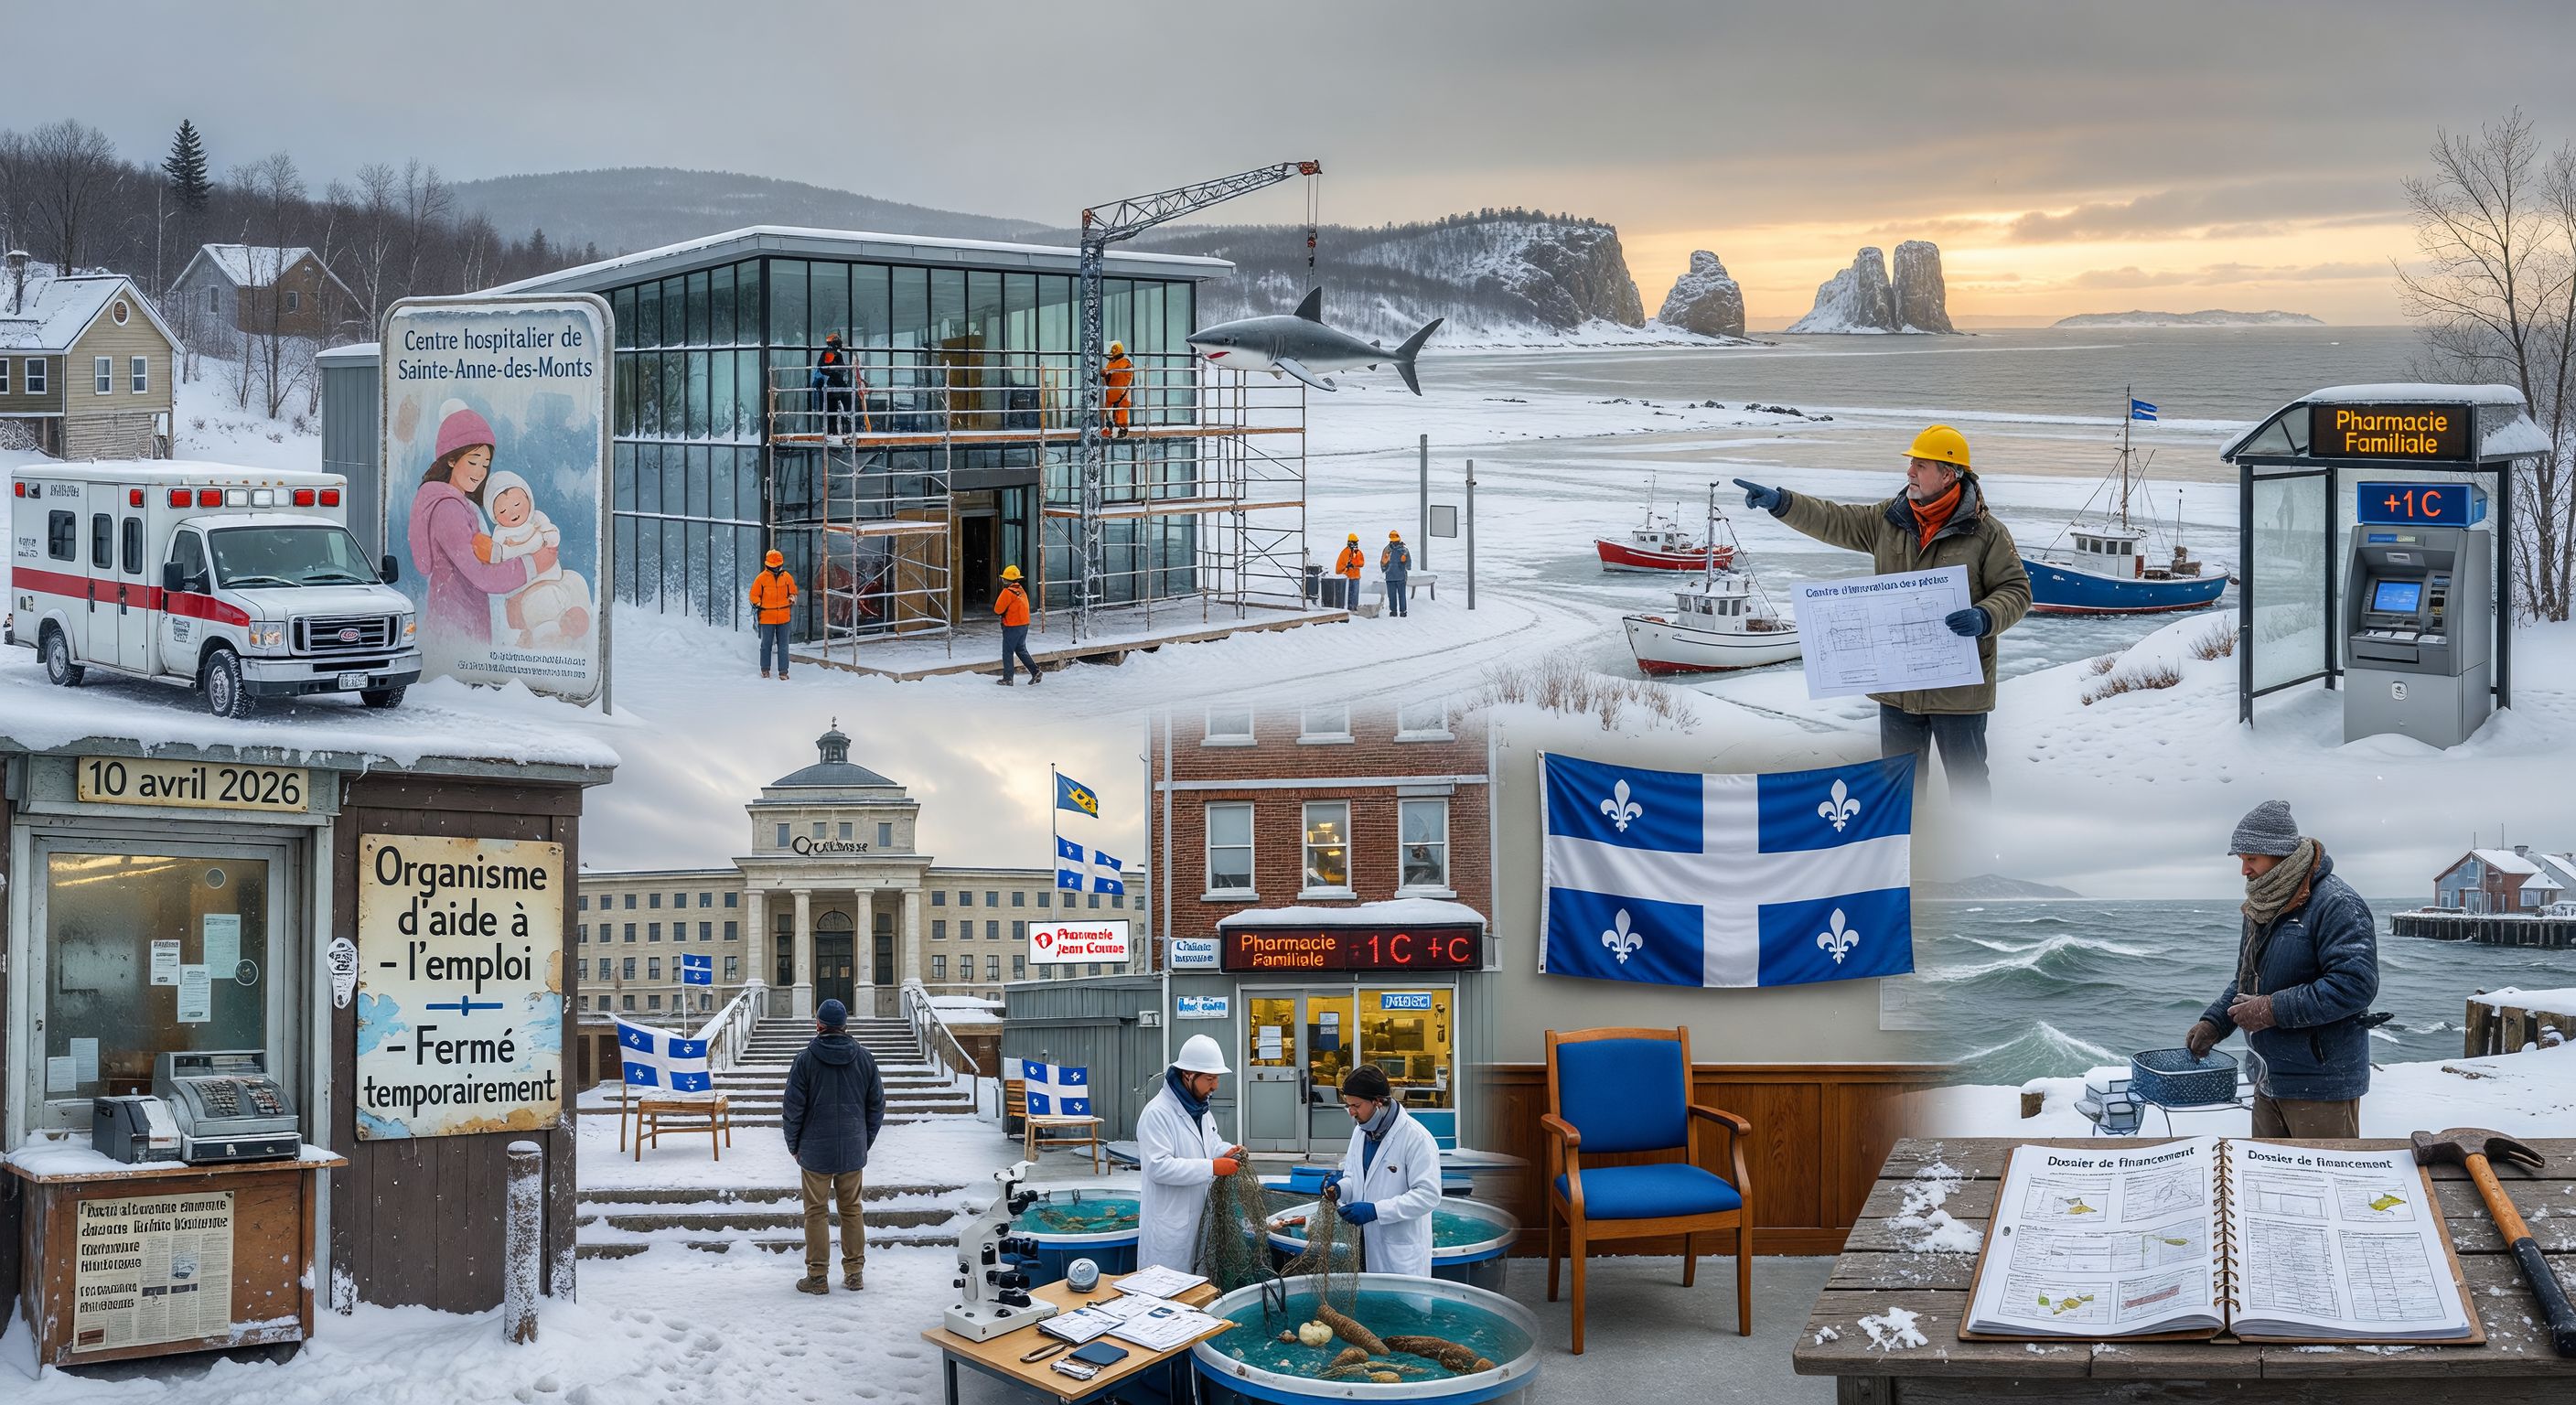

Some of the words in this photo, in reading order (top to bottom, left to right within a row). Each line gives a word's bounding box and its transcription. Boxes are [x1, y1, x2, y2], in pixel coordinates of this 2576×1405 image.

[404, 329, 458, 351] Centre
[464, 327, 555, 354] hospitalier
[561, 325, 583, 348] de
[398, 356, 593, 381] Sainte-Anne-des-Monts
[2336, 410, 2448, 432] Pharmacie
[2345, 432, 2438, 454] Familiale
[89, 759, 128, 798] 10
[138, 766, 207, 801] avril
[219, 768, 302, 806] 2026
[375, 845, 548, 900] Organisme
[398, 896, 499, 937] d'aide
[510, 901, 529, 937] à
[1241, 933, 1336, 952] Pharmacie
[416, 1024, 515, 1066] Fermé
[364, 1069, 557, 1119] temporairement
[2297, 1155, 2313, 1166] de
